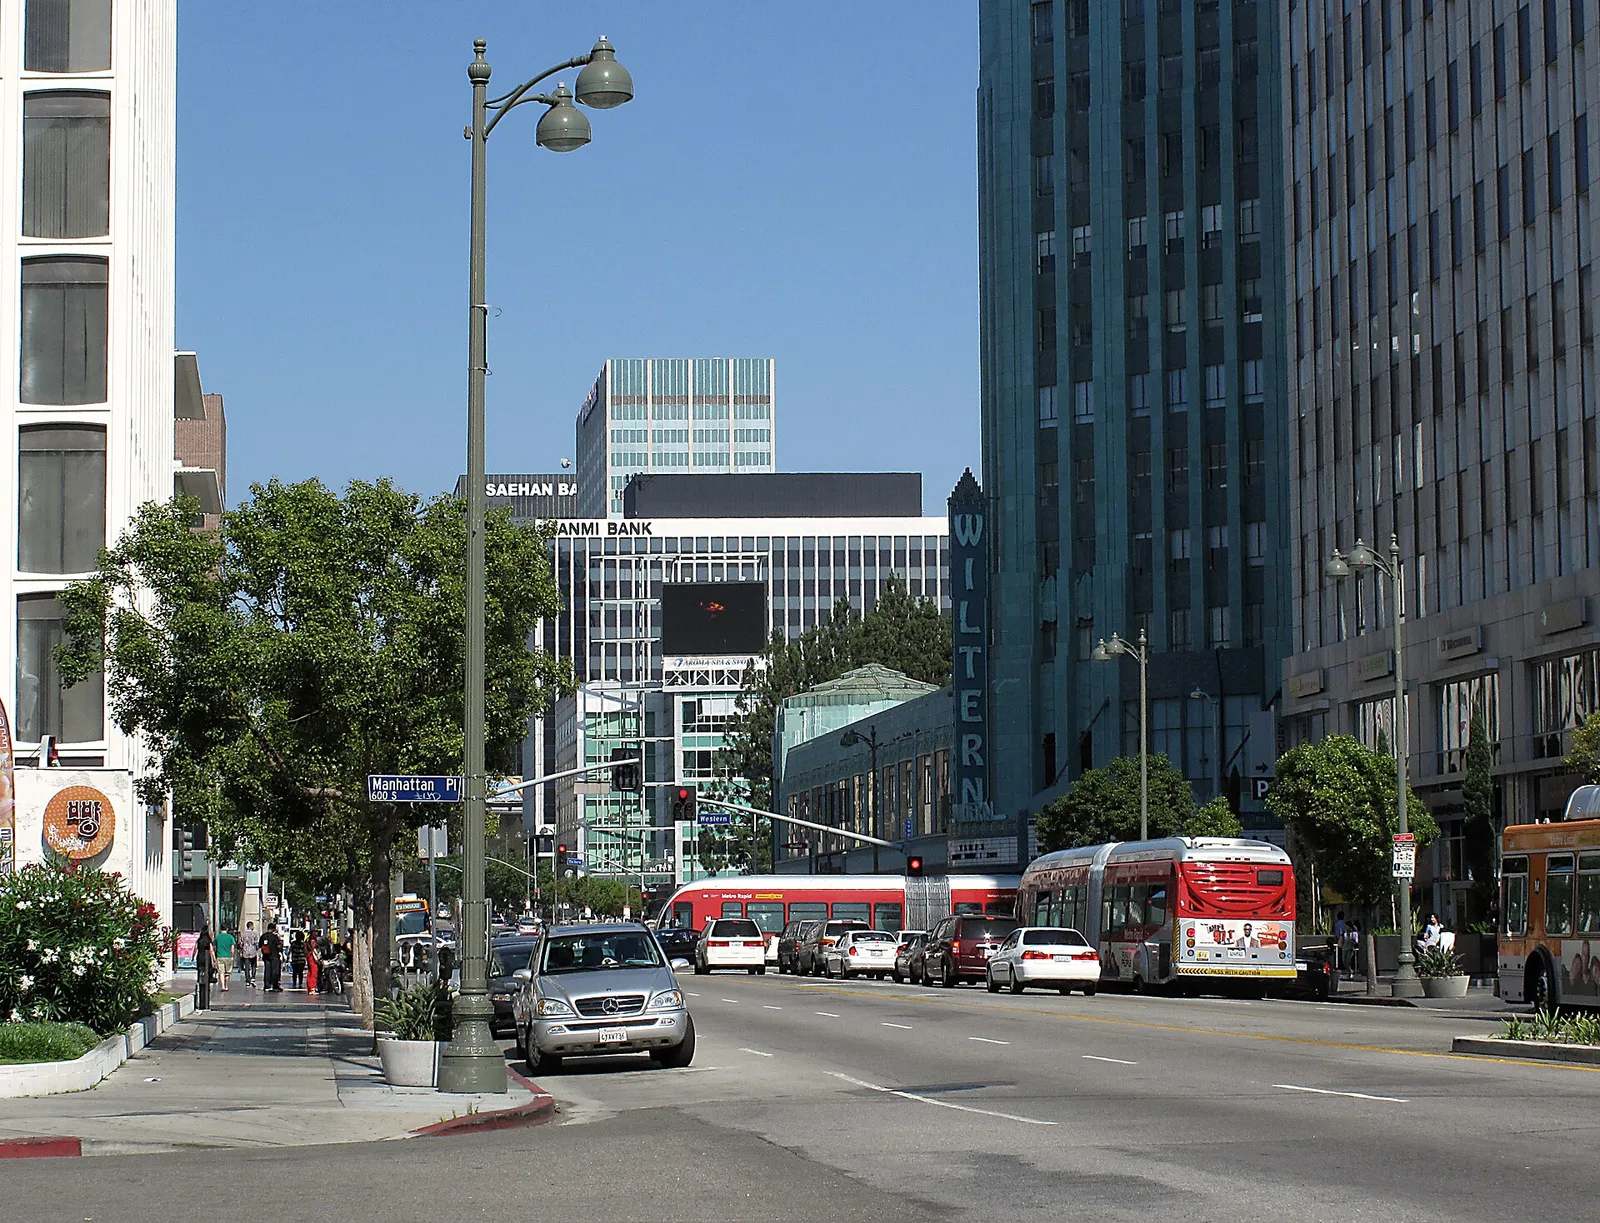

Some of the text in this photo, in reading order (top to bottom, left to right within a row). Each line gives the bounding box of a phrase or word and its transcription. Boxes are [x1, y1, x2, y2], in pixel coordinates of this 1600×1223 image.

[485, 482, 553, 497] SAEHAN
[557, 521, 653, 536] ANMI BANK
[953, 513, 984, 809] WILTERN
[372, 777, 435, 791] Manhattan
[1256, 780, 1269, 797] P
[371, 791, 398, 800] 600 S
[700, 814, 728, 823] Western
